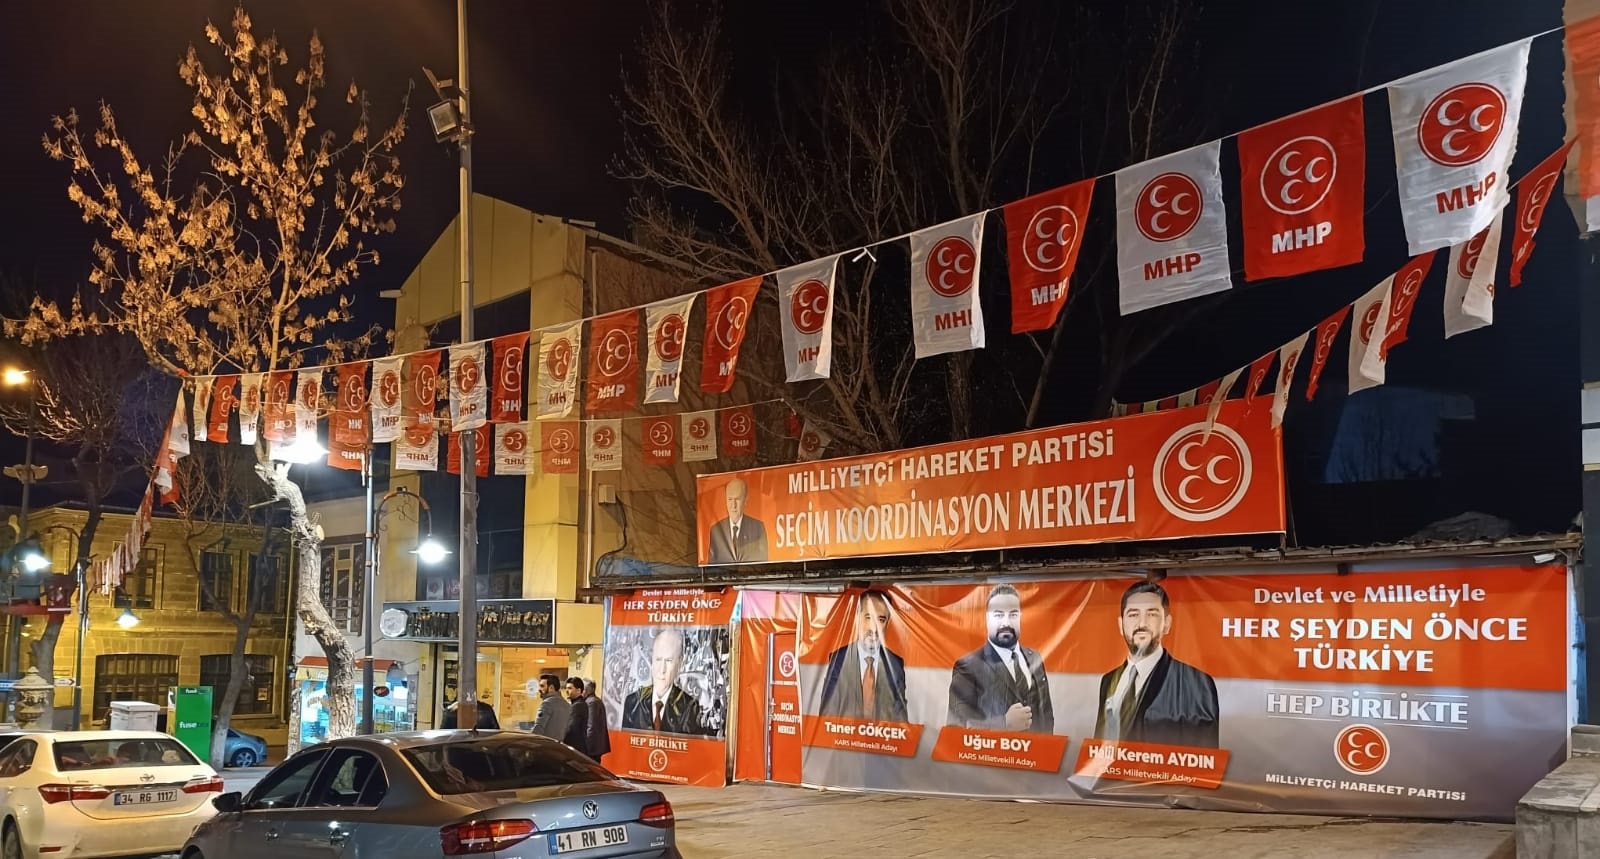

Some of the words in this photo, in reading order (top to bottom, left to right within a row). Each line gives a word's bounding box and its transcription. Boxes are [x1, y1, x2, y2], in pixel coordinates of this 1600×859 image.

[1436, 171, 1497, 214] MHP
[1271, 221, 1333, 254] MHP
[1143, 252, 1202, 282] MHP
[798, 345, 820, 365] MH
[655, 372, 678, 389] MH
[548, 391, 567, 406] MH
[597, 384, 626, 400] MHP
[900, 444, 1005, 481] HAREKET
[775, 502, 830, 556] SEÇİM
[836, 489, 1010, 545] KOORDİNASYON
[1018, 465, 1136, 531] MERKEZİ
[623, 600, 644, 610] HER
[1254, 586, 1324, 604] Devlet
[1330, 590, 1356, 604] ve
[1363, 583, 1486, 608] Milletiyle
[647, 610, 695, 623] TÜRKİYE
[1221, 617, 1280, 638] HER
[1290, 617, 1412, 642] ŞEYDEN
[1424, 612, 1527, 641] ÖNCE
[1293, 642, 1434, 672] TÜRKİYE
[1266, 692, 1323, 715] HEP
[1331, 690, 1468, 724] BİRLİKTE
[824, 721, 856, 735] Taner
[858, 722, 907, 741] GÖKÇEK
[630, 735, 647, 746] HEP
[648, 735, 689, 751] BİRLİKTE
[963, 734, 997, 750] Uğur
[1000, 737, 1032, 752] BOY
[958, 751, 977, 760] KARS
[1015, 758, 1037, 768] Adayı
[1117, 747, 1164, 764] Kerem
[1167, 751, 1215, 770] AYDIN
[1123, 769, 1170, 780] Milletvekili
[121, 794, 133, 804] 34
[139, 792, 152, 802] RG
[157, 791, 174, 801] 1117
[1339, 781, 1404, 797] HAREKET
[557, 833, 573, 851] 41
[581, 830, 597, 848] RN
[603, 827, 626, 844] 908
